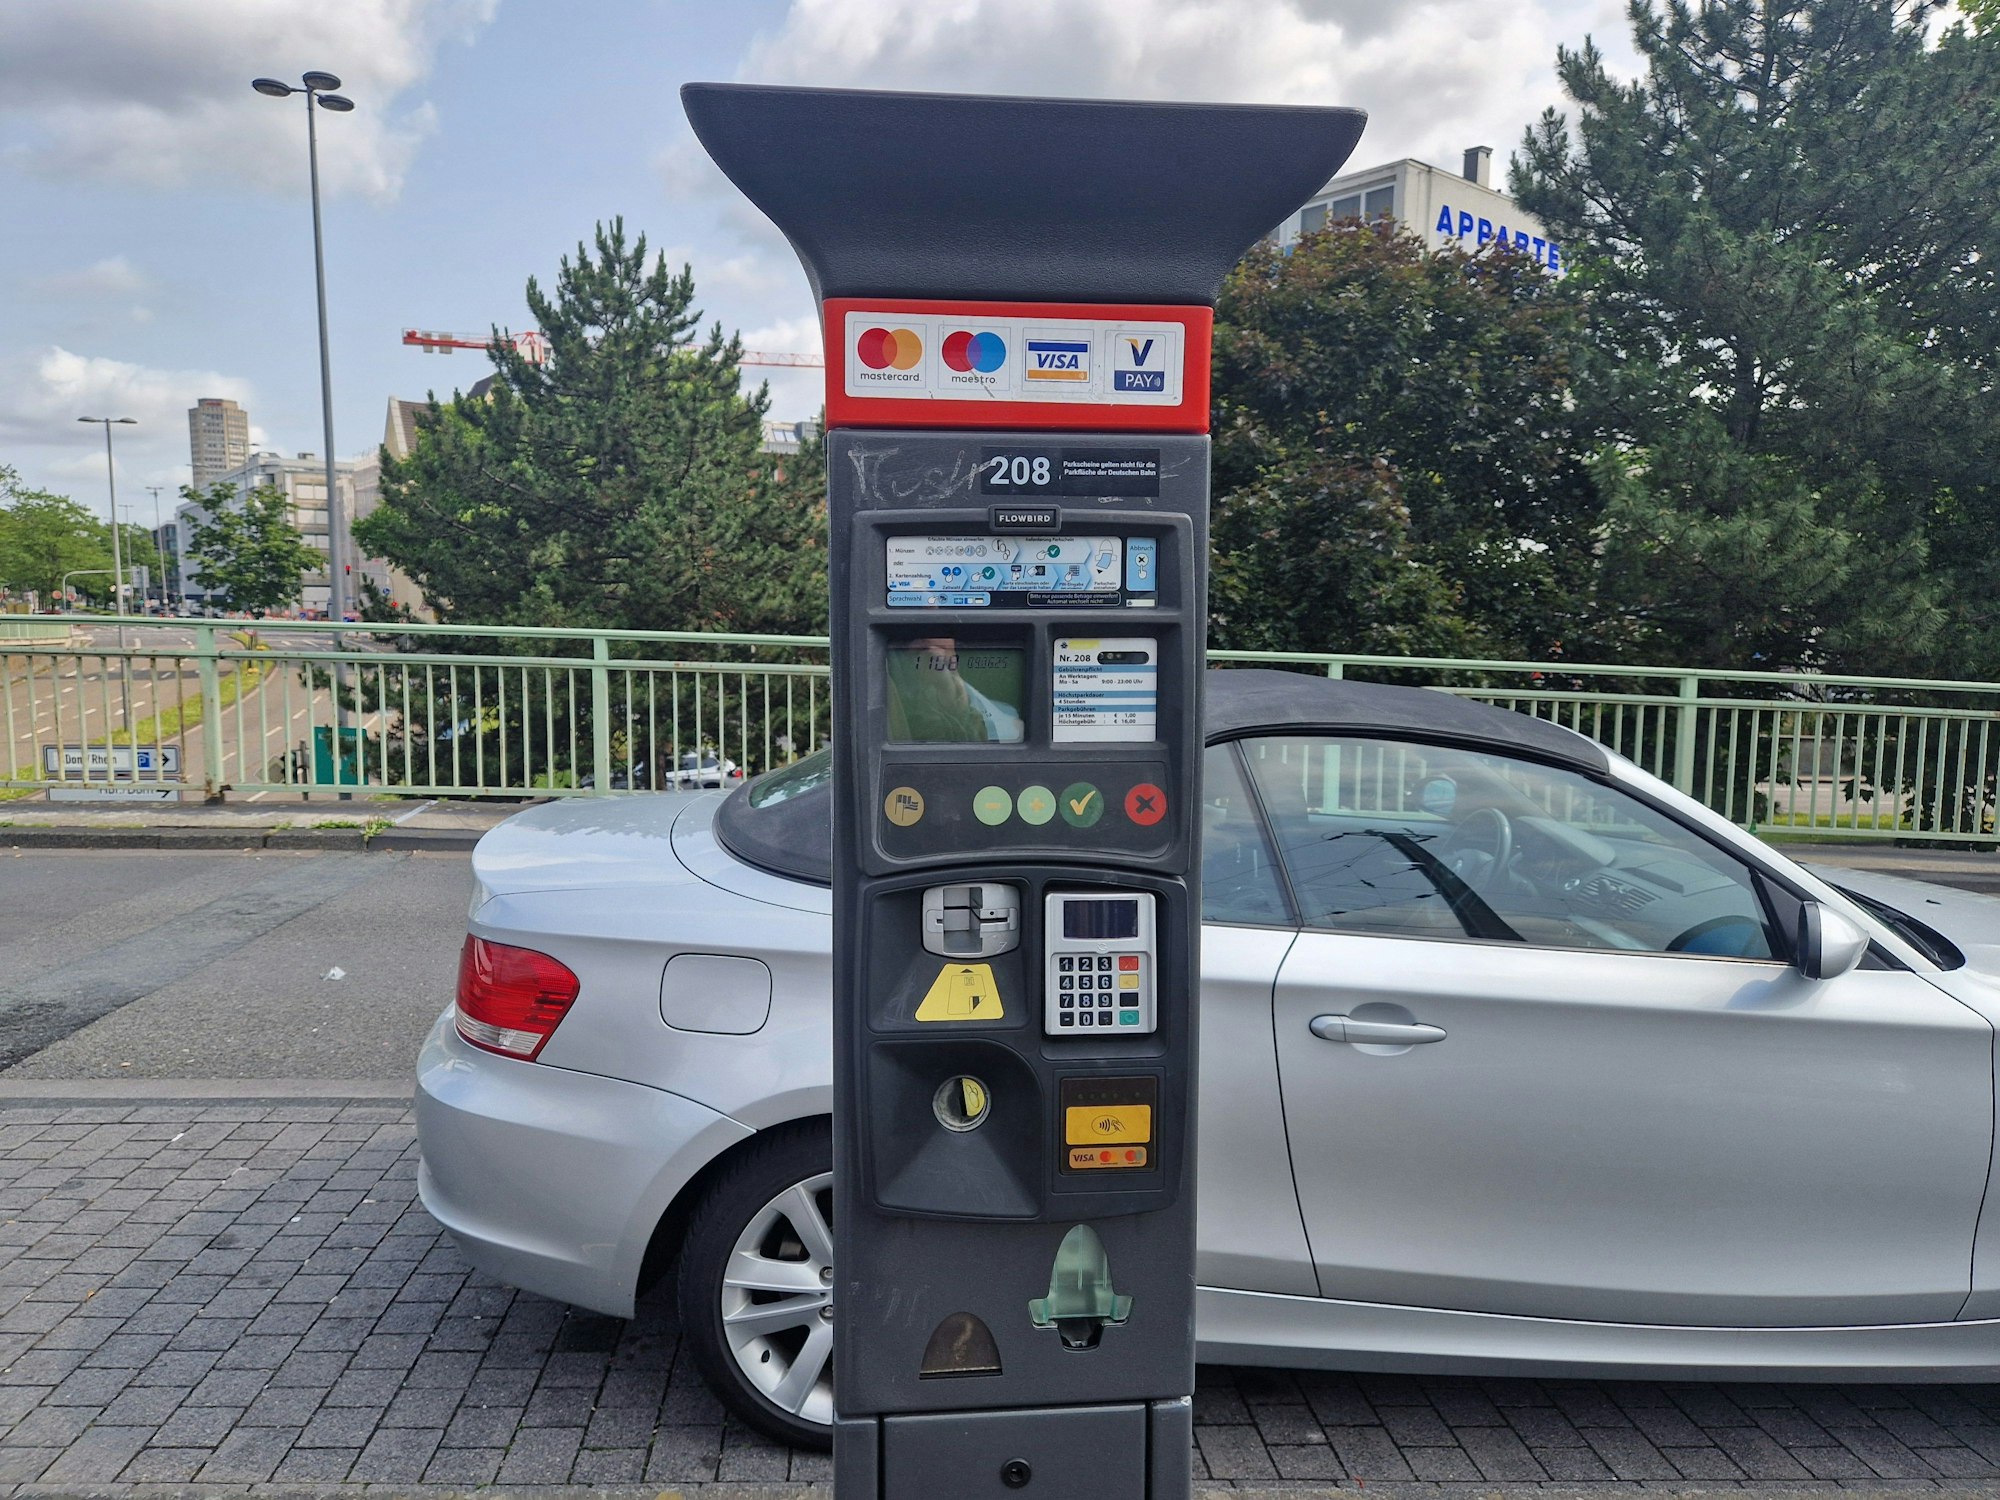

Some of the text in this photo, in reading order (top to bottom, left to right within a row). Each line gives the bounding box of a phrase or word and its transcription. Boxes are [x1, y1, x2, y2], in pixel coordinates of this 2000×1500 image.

[1436, 204, 1568, 273] APPARTE
[1036, 353, 1080, 370] VISA
[860, 372, 920, 382] mastercard
[951, 375, 996, 384] maestro
[1125, 373, 1153, 388] PAY
[990, 456, 1051, 485] 208
[1101, 461, 1119, 469] gelten
[1062, 958, 1109, 970] 1 2 3
[1062, 977, 1109, 989] 4 5 6
[1062, 995, 1109, 1007] 7 8 9
[1083, 1014, 1090, 1025] 0
[1073, 1154, 1095, 1162] VISA
